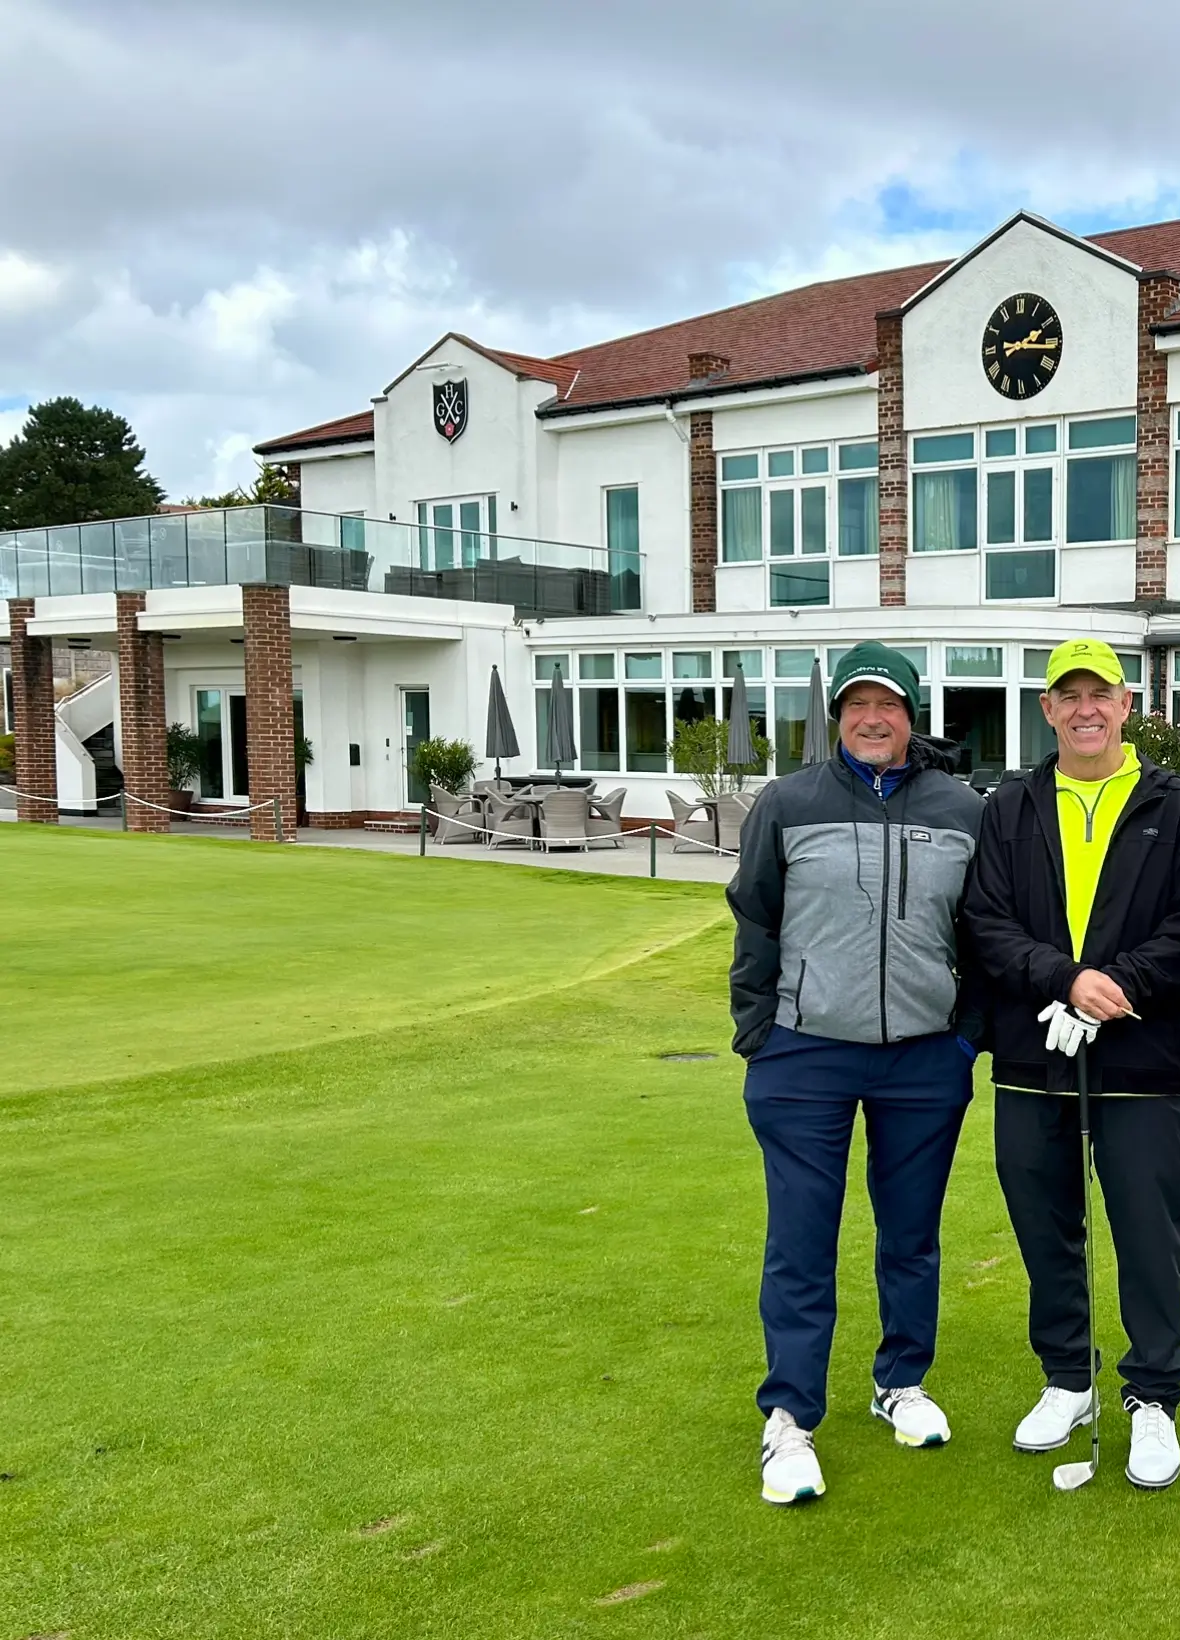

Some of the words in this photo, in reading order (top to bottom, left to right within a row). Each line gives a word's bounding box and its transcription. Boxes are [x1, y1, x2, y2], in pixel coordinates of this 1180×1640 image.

[1041, 316, 1054, 329] II
[445, 384, 454, 399] H
[436, 403, 446, 417] G
[454, 400, 463, 415] C
